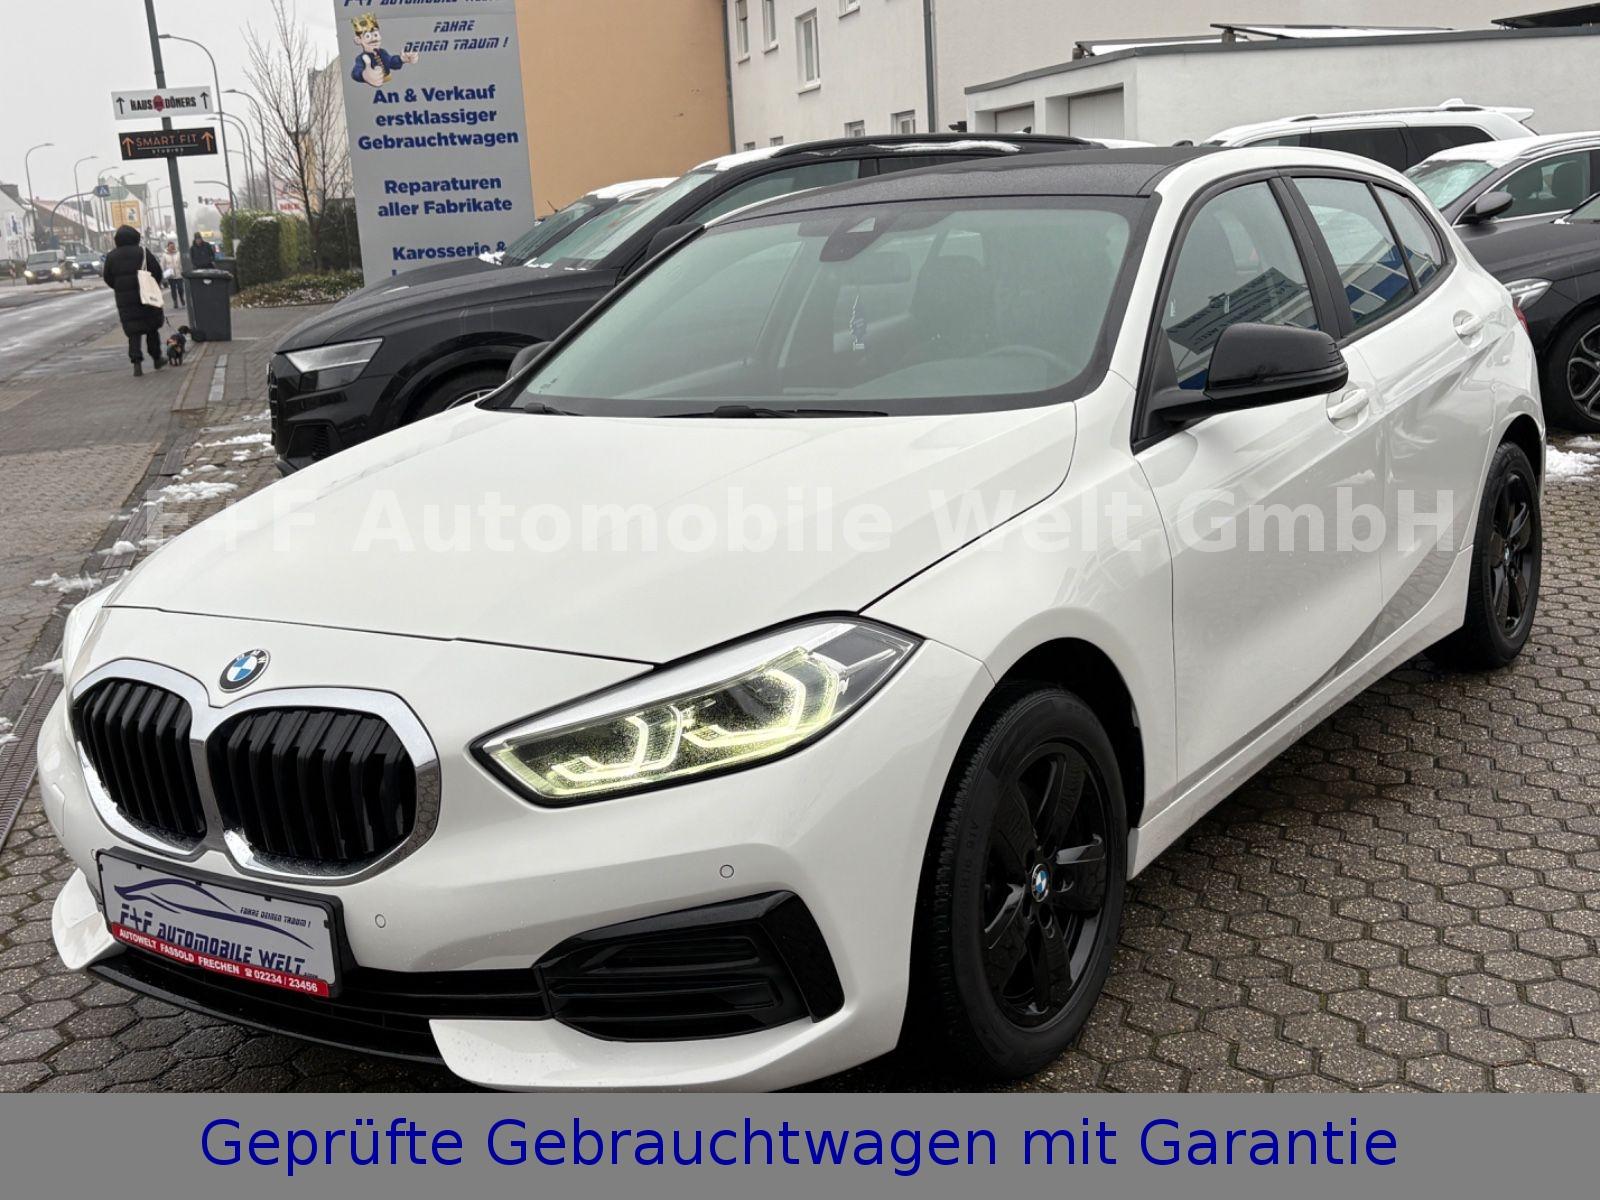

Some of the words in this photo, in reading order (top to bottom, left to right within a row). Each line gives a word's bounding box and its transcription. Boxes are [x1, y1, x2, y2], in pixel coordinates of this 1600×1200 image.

[434, 20, 475, 33] FAHRE
[404, 41, 447, 53] DEINEN
[454, 37, 499, 50] TRAUM
[503, 37, 509, 48] !
[130, 98, 153, 111] HAUS
[164, 96, 197, 109] DÖNERS
[373, 90, 399, 104] An
[404, 88, 417, 102] &
[422, 84, 496, 102] Verkauf
[375, 108, 497, 127] erstklassiger
[135, 135, 175, 147] SMART
[179, 133, 197, 143] FIT
[358, 131, 519, 150] Gebrauchtwagen
[384, 176, 502, 195] Reparaturen
[378, 202, 419, 217] aller
[424, 198, 513, 215] Fabrikate
[392, 242, 490, 260] Karosserie
[121, 903, 153, 933] F+F
[157, 922, 253, 963] AUTOMOBILE
[259, 949, 306, 975] WELT
[120, 929, 157, 949] AUTOWELT
[160, 943, 195, 963] FASSOLD
[198, 956, 240, 975] FRECHEN
[253, 969, 282, 985] 02234
[288, 977, 318, 993] 23456
